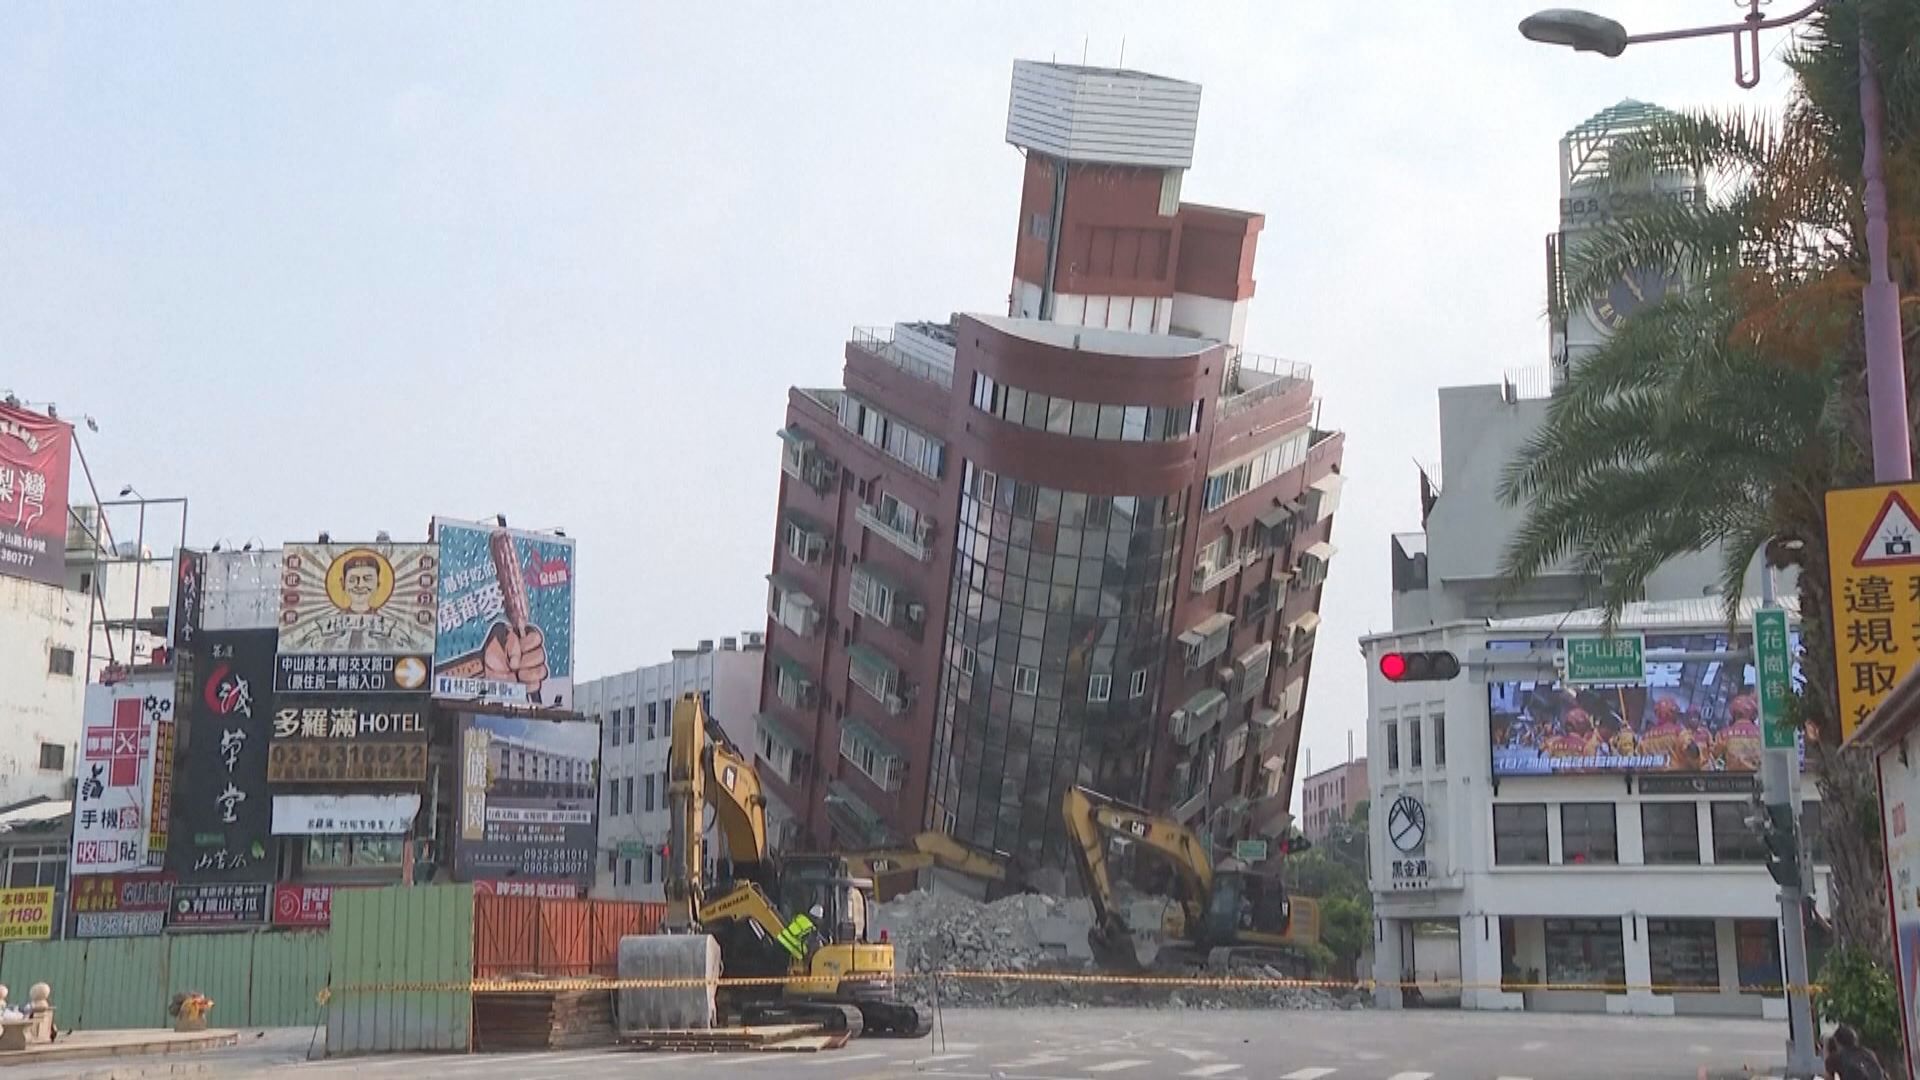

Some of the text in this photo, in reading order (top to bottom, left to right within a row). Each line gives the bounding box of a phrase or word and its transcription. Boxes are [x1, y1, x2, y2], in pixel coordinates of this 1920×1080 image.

[1576, 640, 1634, 659] 中山路
[273, 707, 424, 738] 多羅滿 HOTEL
